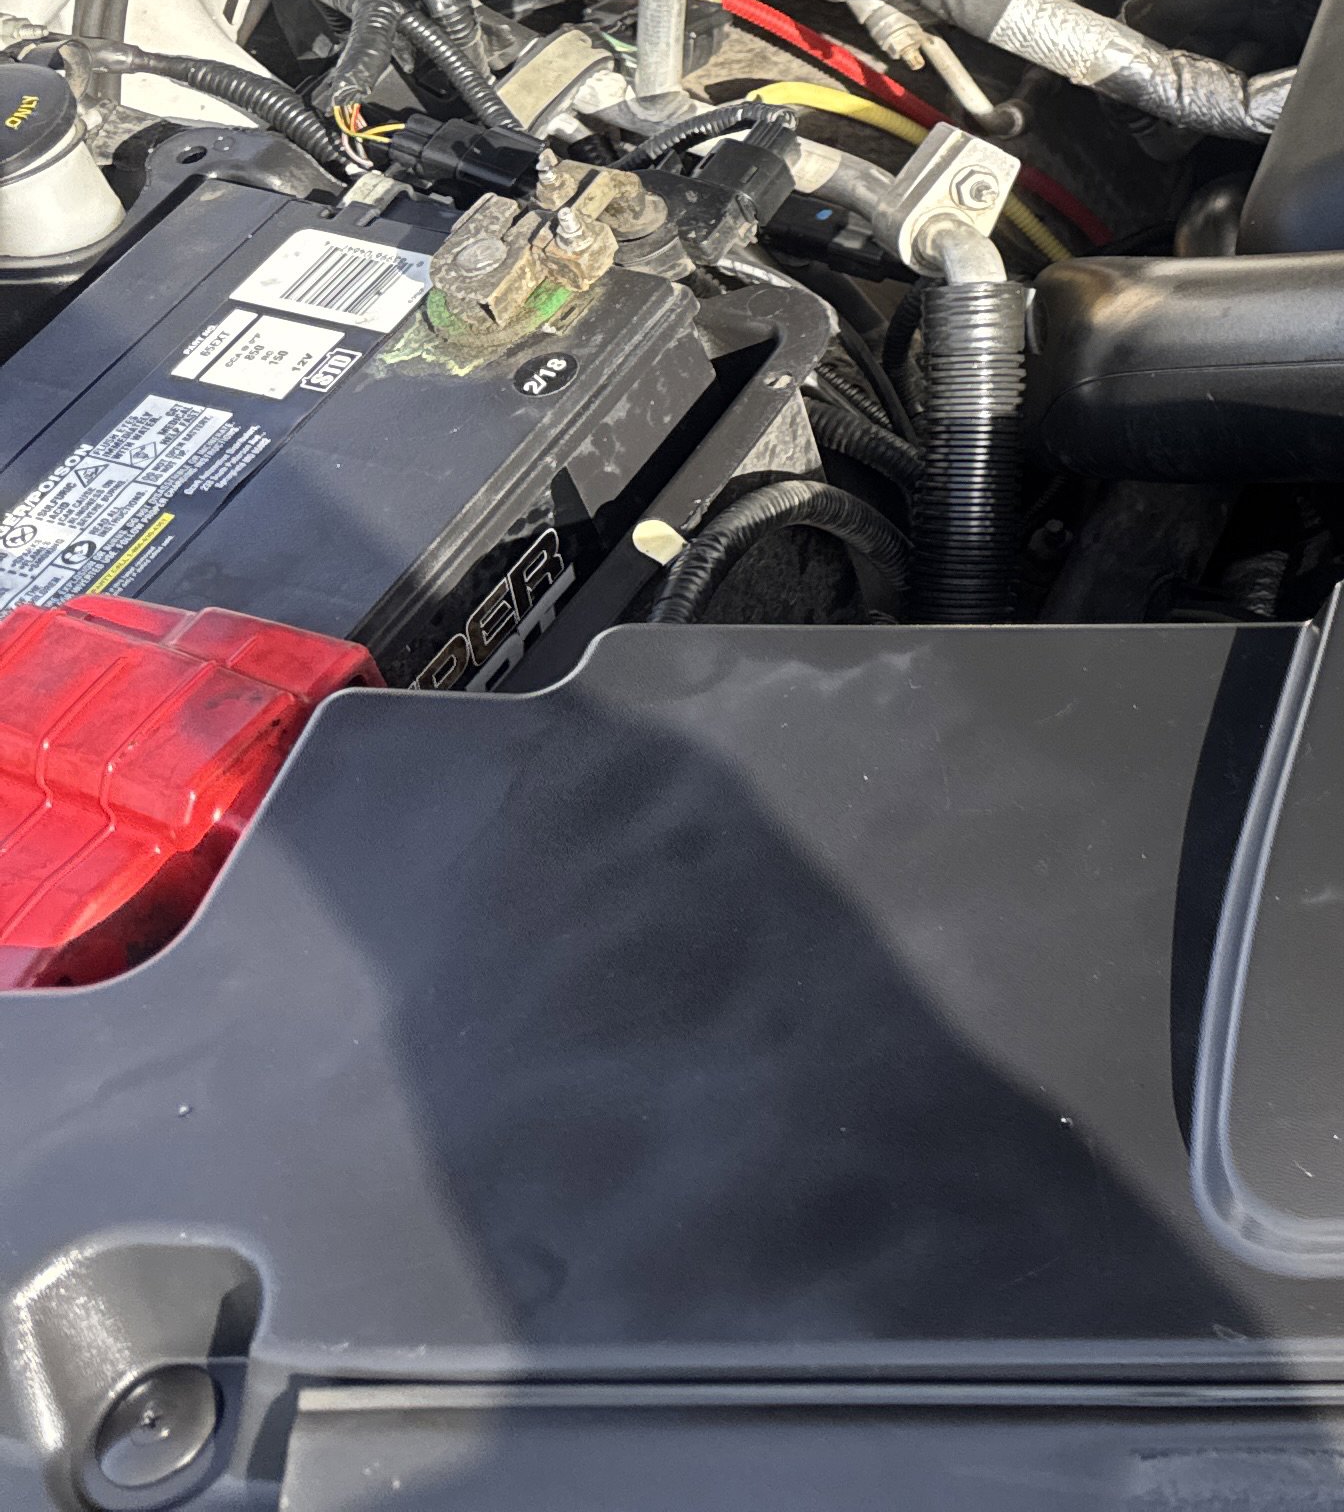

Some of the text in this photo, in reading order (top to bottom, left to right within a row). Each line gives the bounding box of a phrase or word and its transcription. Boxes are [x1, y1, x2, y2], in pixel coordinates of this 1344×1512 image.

[5, 95, 39, 130] ONLY
[181, 336, 205, 354] PART
[242, 344, 266, 360] 850
[266, 350, 290, 365] 150
[289, 353, 316, 372] 12V
[309, 353, 356, 386] STD
[522, 358, 567, 394] 2/18
[157, 407, 194, 436] MEDICAL
[101, 413, 155, 457] IMMEDIATELY
[112, 442, 136, 459] WITH
[35, 482, 77, 516] SULFURIC
[47, 501, 71, 518] ACID
